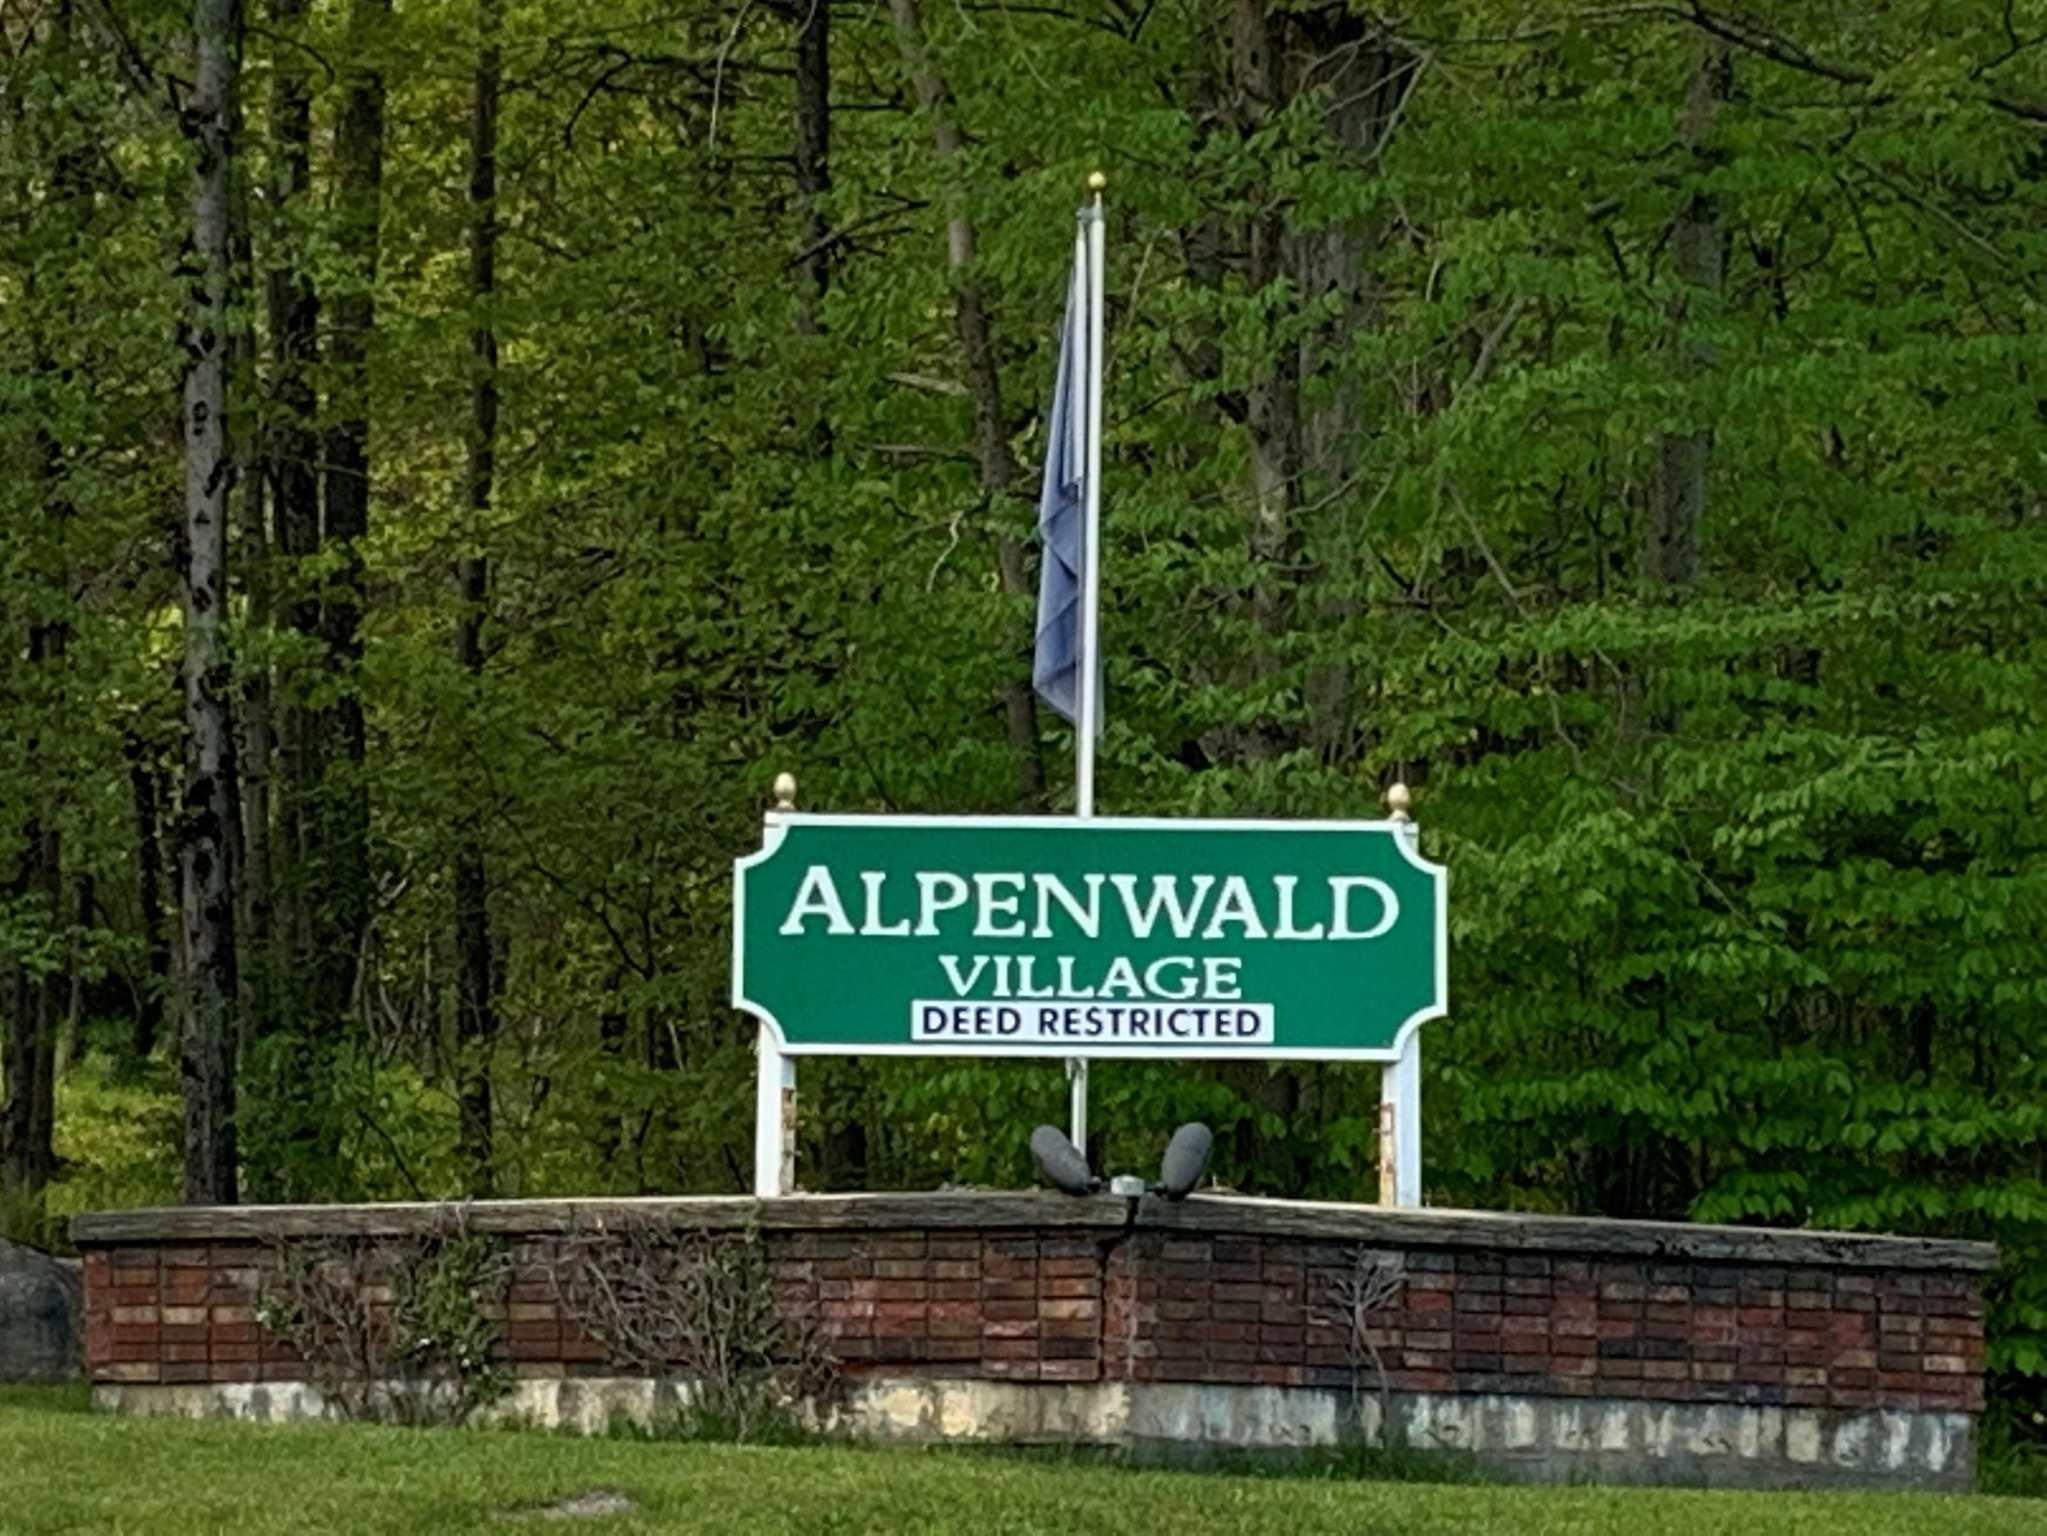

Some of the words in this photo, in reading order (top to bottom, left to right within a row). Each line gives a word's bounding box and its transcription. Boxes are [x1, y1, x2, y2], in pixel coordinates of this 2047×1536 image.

[779, 865, 1400, 941] ALPENWALD
[938, 955, 1242, 999] VILLAGE
[922, 1006, 1022, 1035] DEED
[1038, 1007, 1261, 1038] RESTRICTED
